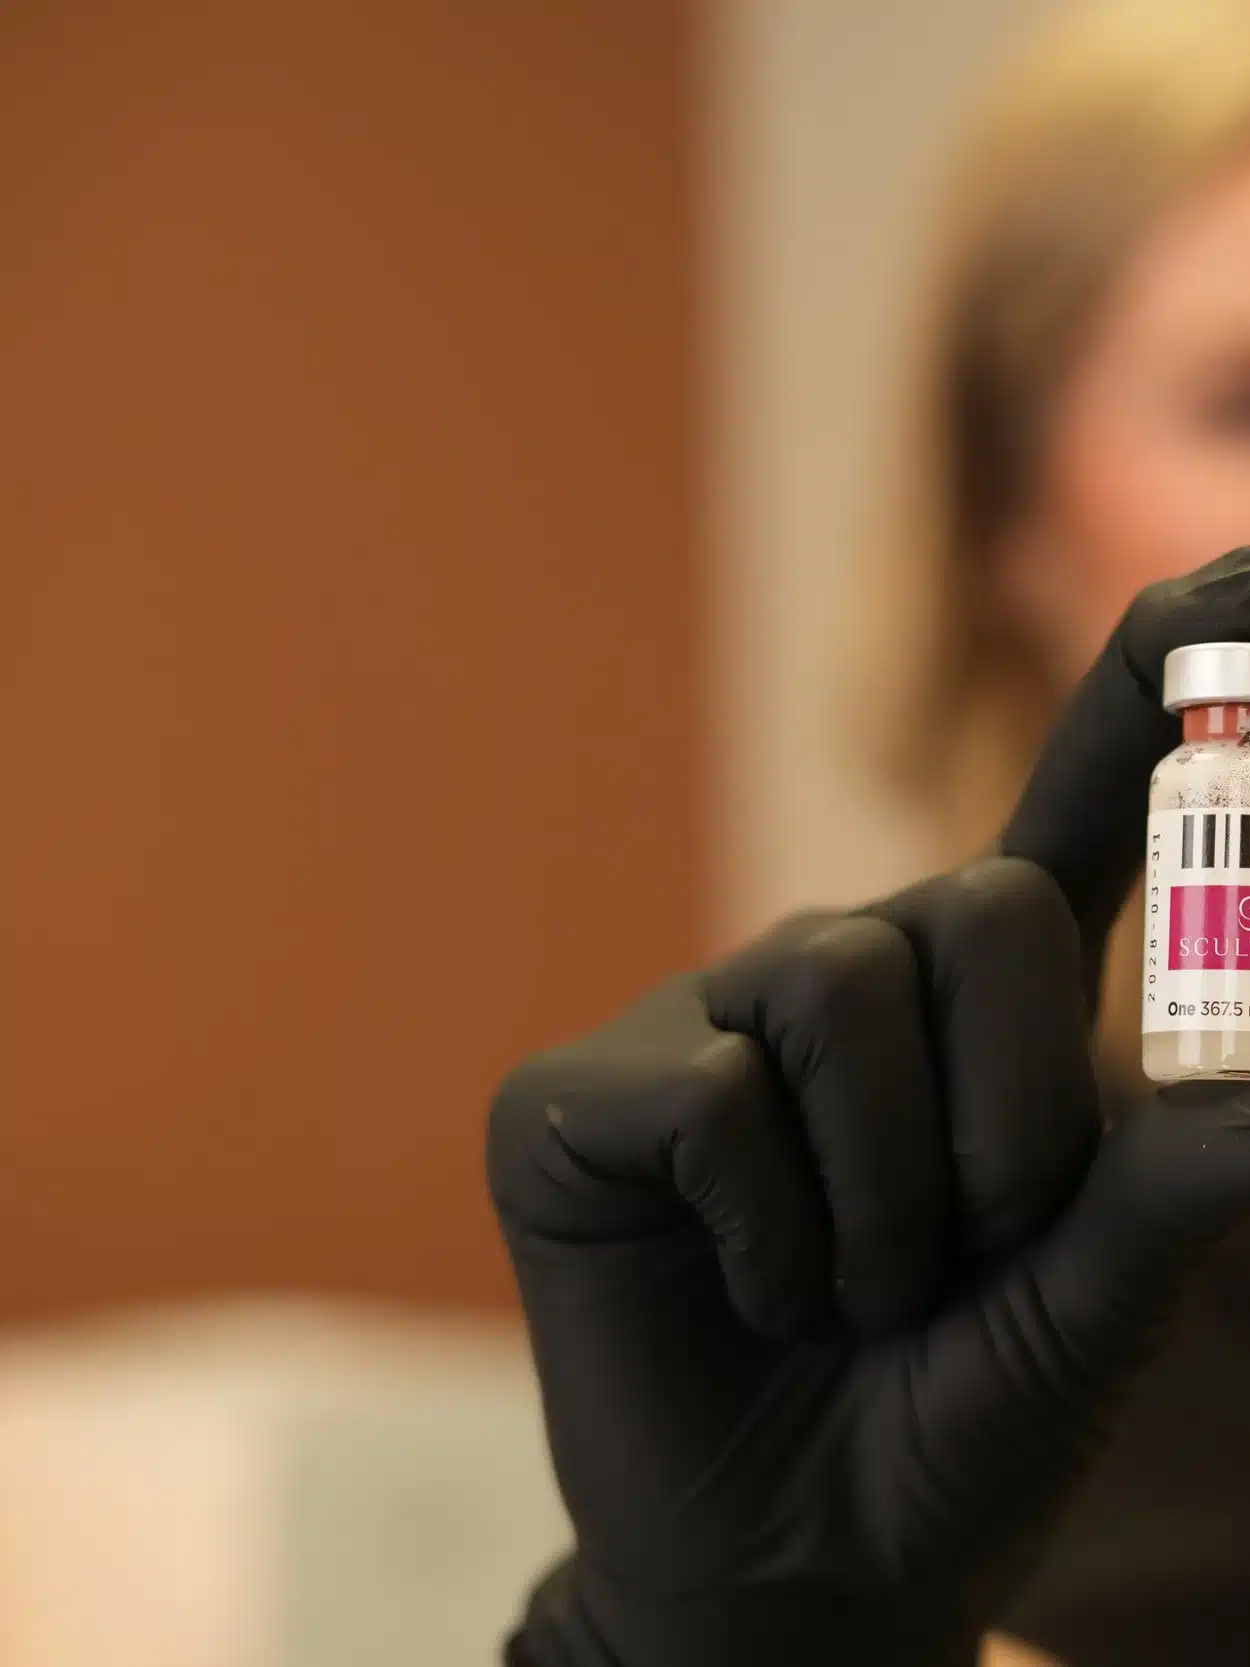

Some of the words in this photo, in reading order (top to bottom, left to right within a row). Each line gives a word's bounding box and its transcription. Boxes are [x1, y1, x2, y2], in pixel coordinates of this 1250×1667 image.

[1148, 833, 1161, 1002] 2028-03-31
[1168, 1001, 1196, 1016] One
[1201, 1001, 1243, 1017] 367.5
